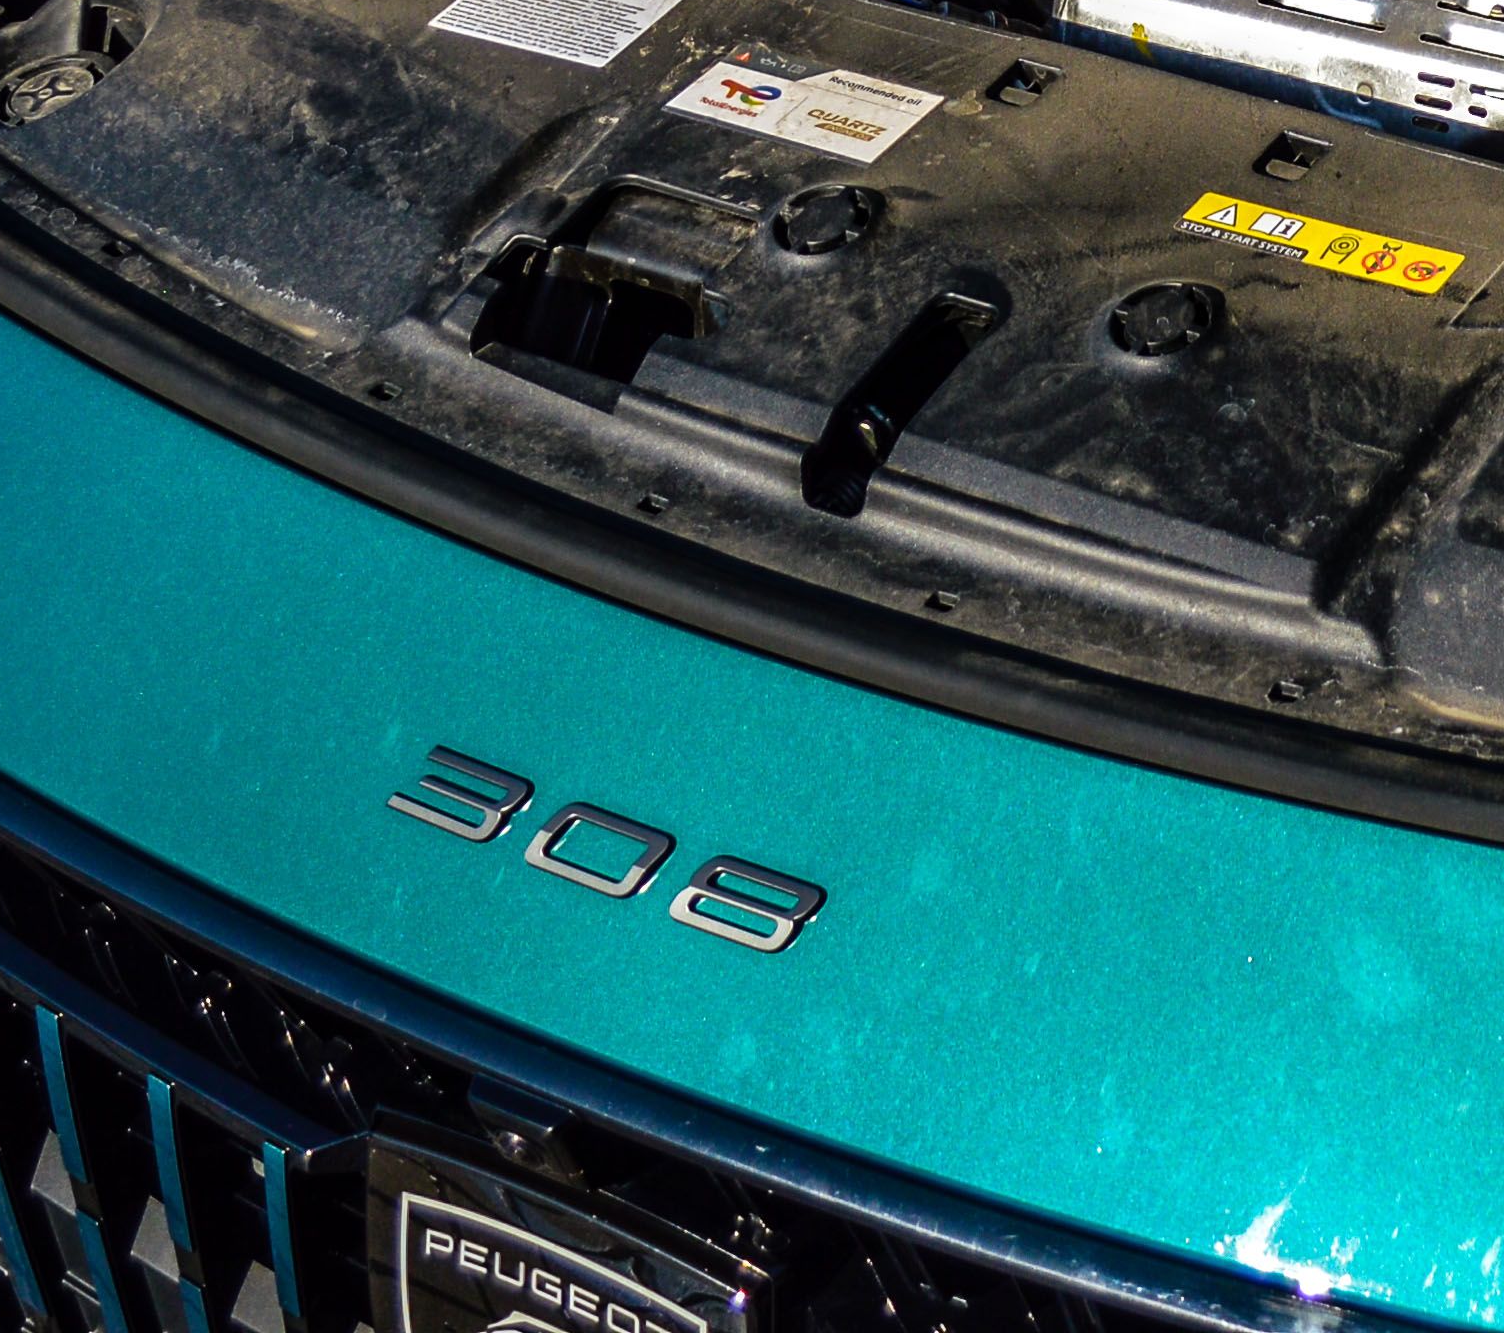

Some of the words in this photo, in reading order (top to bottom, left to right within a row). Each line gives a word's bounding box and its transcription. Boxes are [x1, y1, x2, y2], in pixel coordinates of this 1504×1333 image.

[829, 76, 906, 102] Recommended
[906, 96, 923, 107] oil
[808, 108, 888, 136] QUARTZ
[1180, 221, 1211, 237] STOP
[1211, 228, 1221, 238] &
[1221, 232, 1258, 247] START
[1258, 240, 1304, 259] SYSTEM
[387, 744, 828, 954] 308
